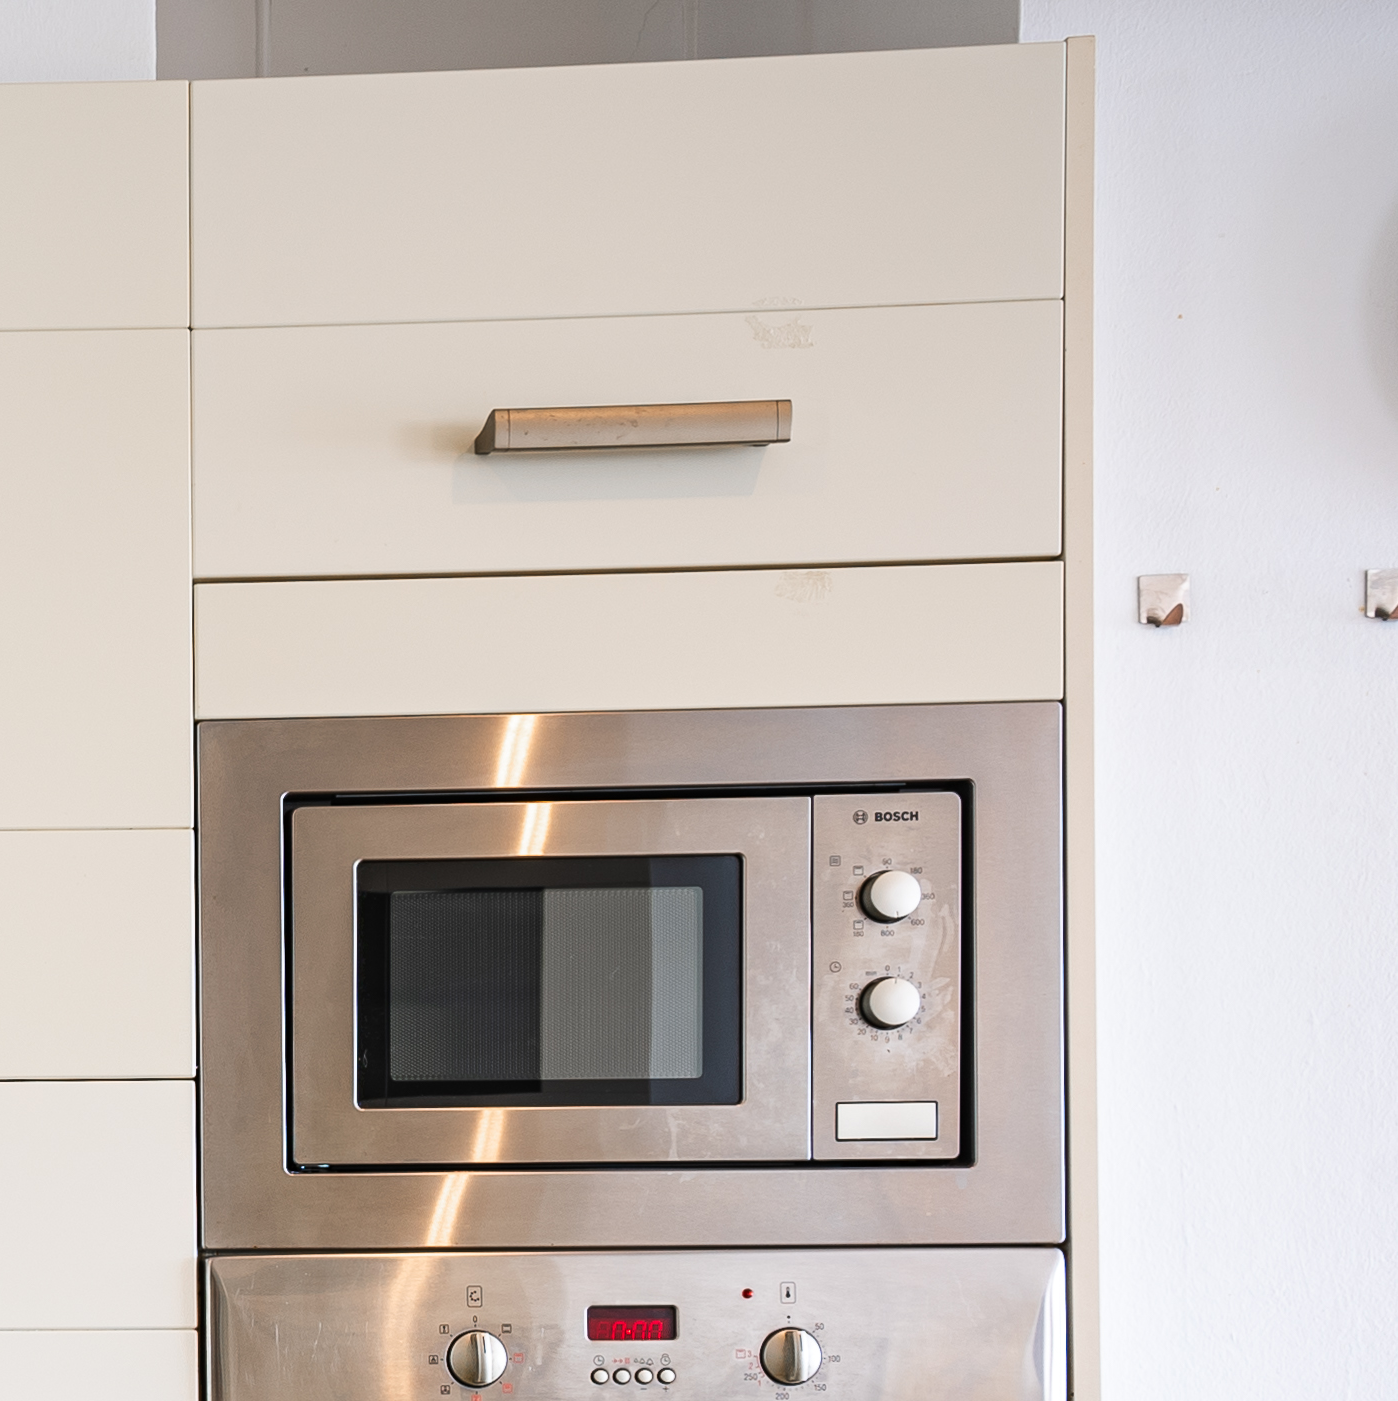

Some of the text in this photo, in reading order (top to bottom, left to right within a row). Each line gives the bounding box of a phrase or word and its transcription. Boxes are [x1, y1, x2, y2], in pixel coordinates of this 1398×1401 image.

[874, 810, 919, 822] BOSCH
[910, 866, 923, 875] 180
[880, 929, 895, 937] 800
[884, 964, 891, 972] 0
[849, 982, 860, 990] 60
[814, 1322, 825, 1331] 50
[828, 1354, 841, 1362] 100
[743, 1372, 759, 1381] 250
[813, 1383, 827, 1392] 150
[775, 1392, 790, 1401] 200
